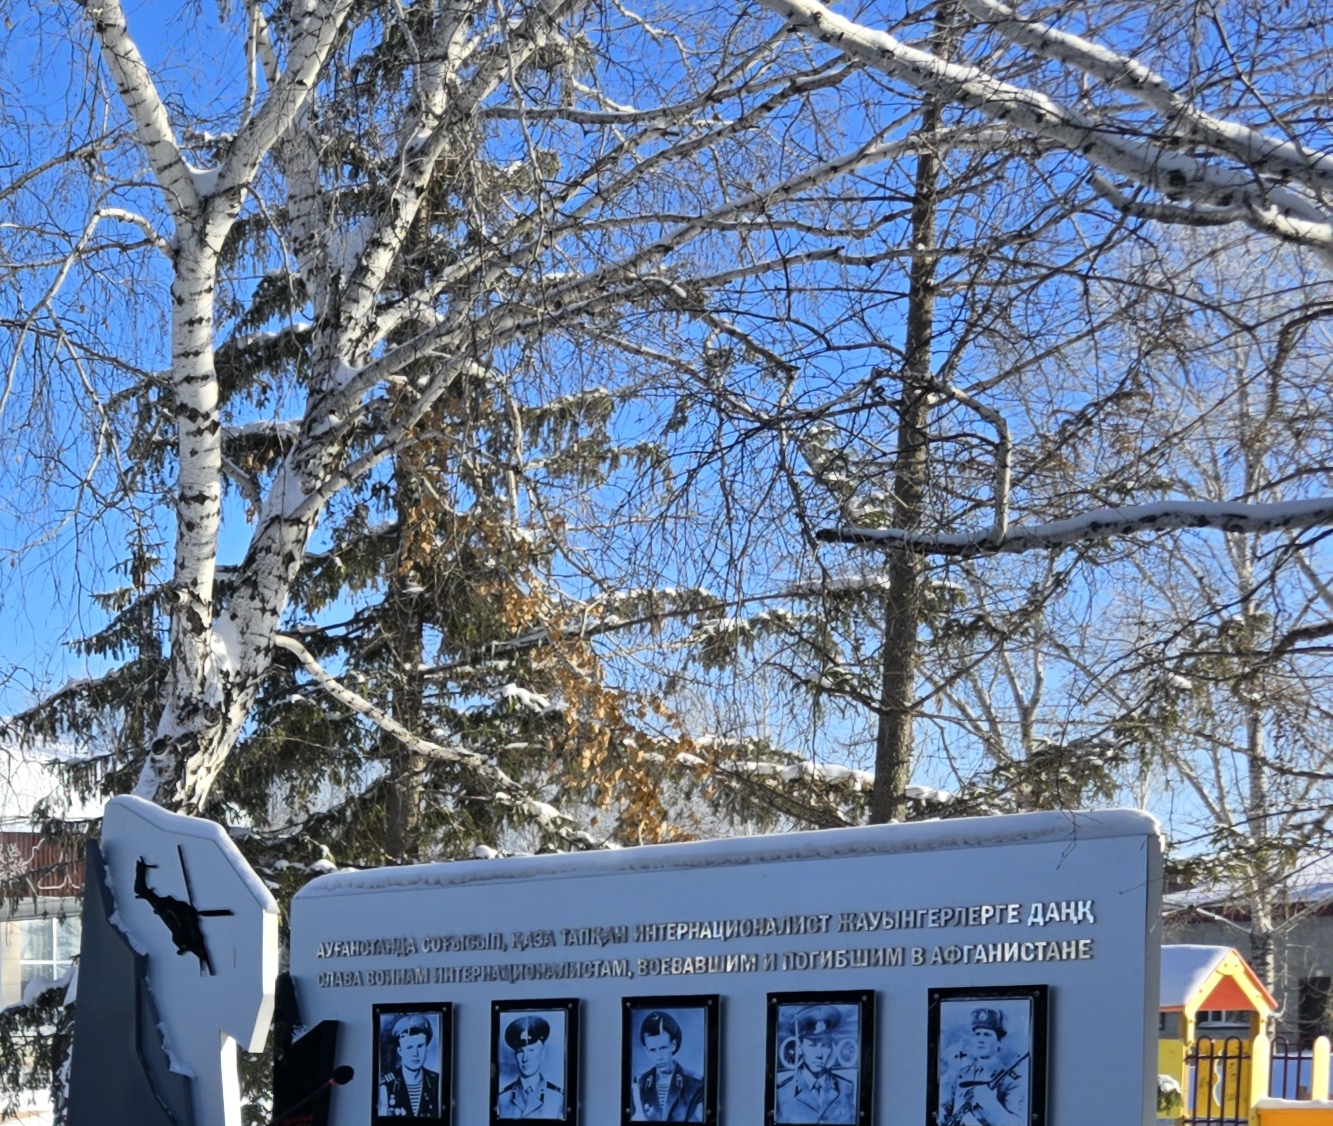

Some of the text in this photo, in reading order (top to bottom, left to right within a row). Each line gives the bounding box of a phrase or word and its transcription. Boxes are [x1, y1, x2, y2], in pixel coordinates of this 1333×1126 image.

[316, 900, 1095, 957] АУҒАНСТАНДА СОҒЫСЫП, ҚАЗА ТАПҚАН ИНТЕРНАЦИОНАЛИСТ ЖАУЫНГЕРЛЕРГЕ ДАҢҚ
[317, 939, 1094, 988] СЛАВА ВОИНАМ ИНТЕРНАЦИОНАЛИСТАМ, ВОЕВАВШИМ И ПОГИБШИМ В АФГАНИСТАНЕ
